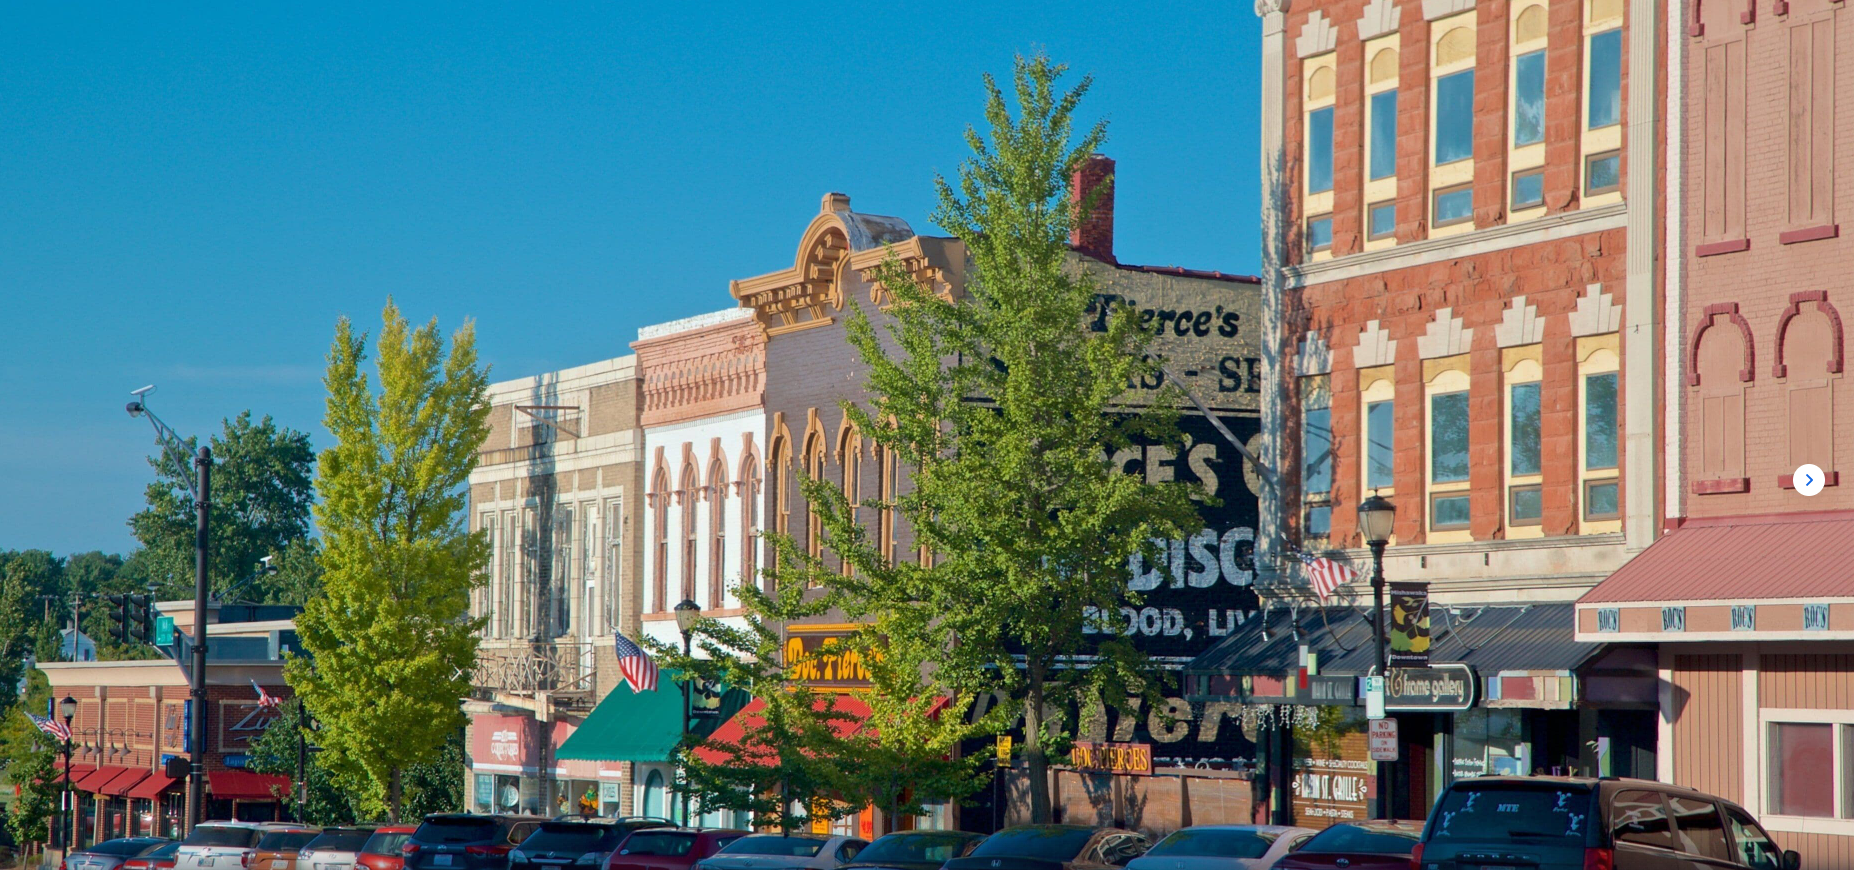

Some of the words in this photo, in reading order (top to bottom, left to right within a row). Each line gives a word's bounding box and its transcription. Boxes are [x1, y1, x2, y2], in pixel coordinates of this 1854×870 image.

[1598, 608, 1618, 631] ROC'S
[1662, 607, 1682, 631] ROC'S
[1731, 606, 1753, 630] ROC'S
[1803, 605, 1827, 630] ROC'S
[1404, 674, 1431, 695] frame
[1432, 673, 1465, 703] gallery
[1372, 731, 1396, 739] PARKING
[1379, 722, 1389, 730] NO
[1333, 775, 1358, 802] GRILLE
[1497, 803, 1520, 813] MTE
